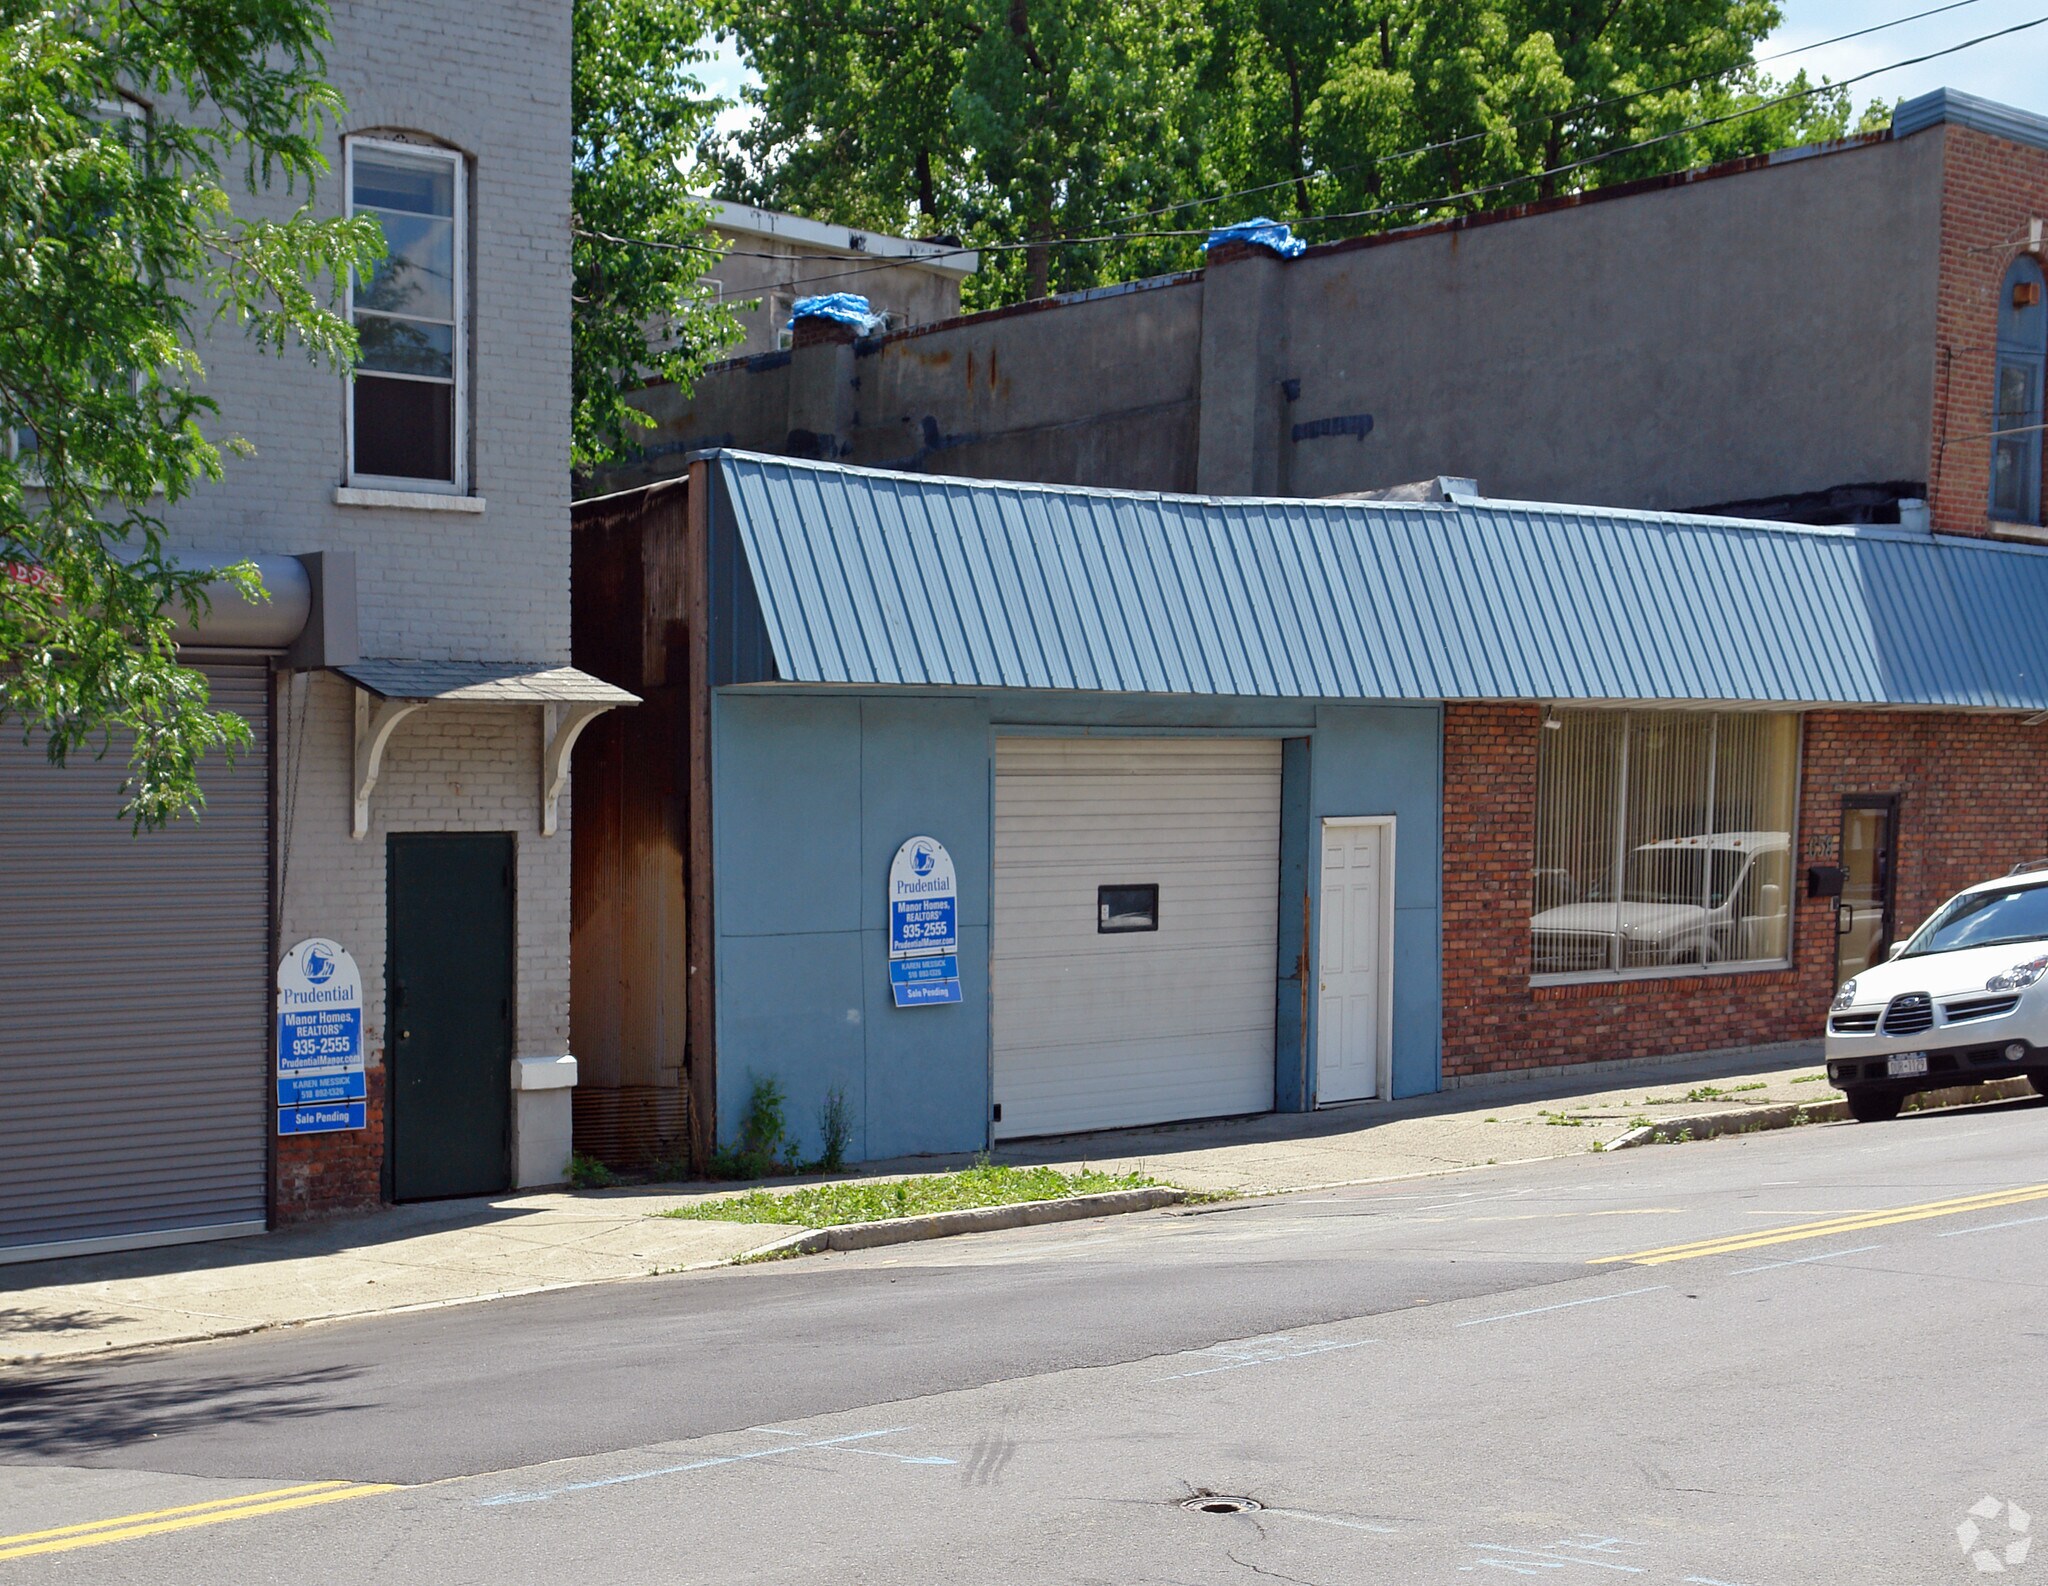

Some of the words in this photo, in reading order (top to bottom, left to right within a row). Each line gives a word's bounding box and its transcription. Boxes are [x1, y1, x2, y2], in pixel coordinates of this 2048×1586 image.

[897, 877, 949, 894] Prudential
[897, 902, 922, 913] Manor
[923, 900, 951, 911] Homes,
[903, 921, 947, 938] 935-2555
[895, 938, 954, 949] PrudentialManor.com
[284, 984, 354, 1005] Prudential
[907, 988, 922, 998] Sale
[922, 987, 949, 998] Pending
[285, 1013, 318, 1026] Manor
[319, 1011, 354, 1024] Homes,
[292, 1036, 350, 1056] 935-2555
[281, 1054, 360, 1069] PrudentialManor.com
[295, 1113, 315, 1125] Sale
[315, 1111, 350, 1124] Pending
